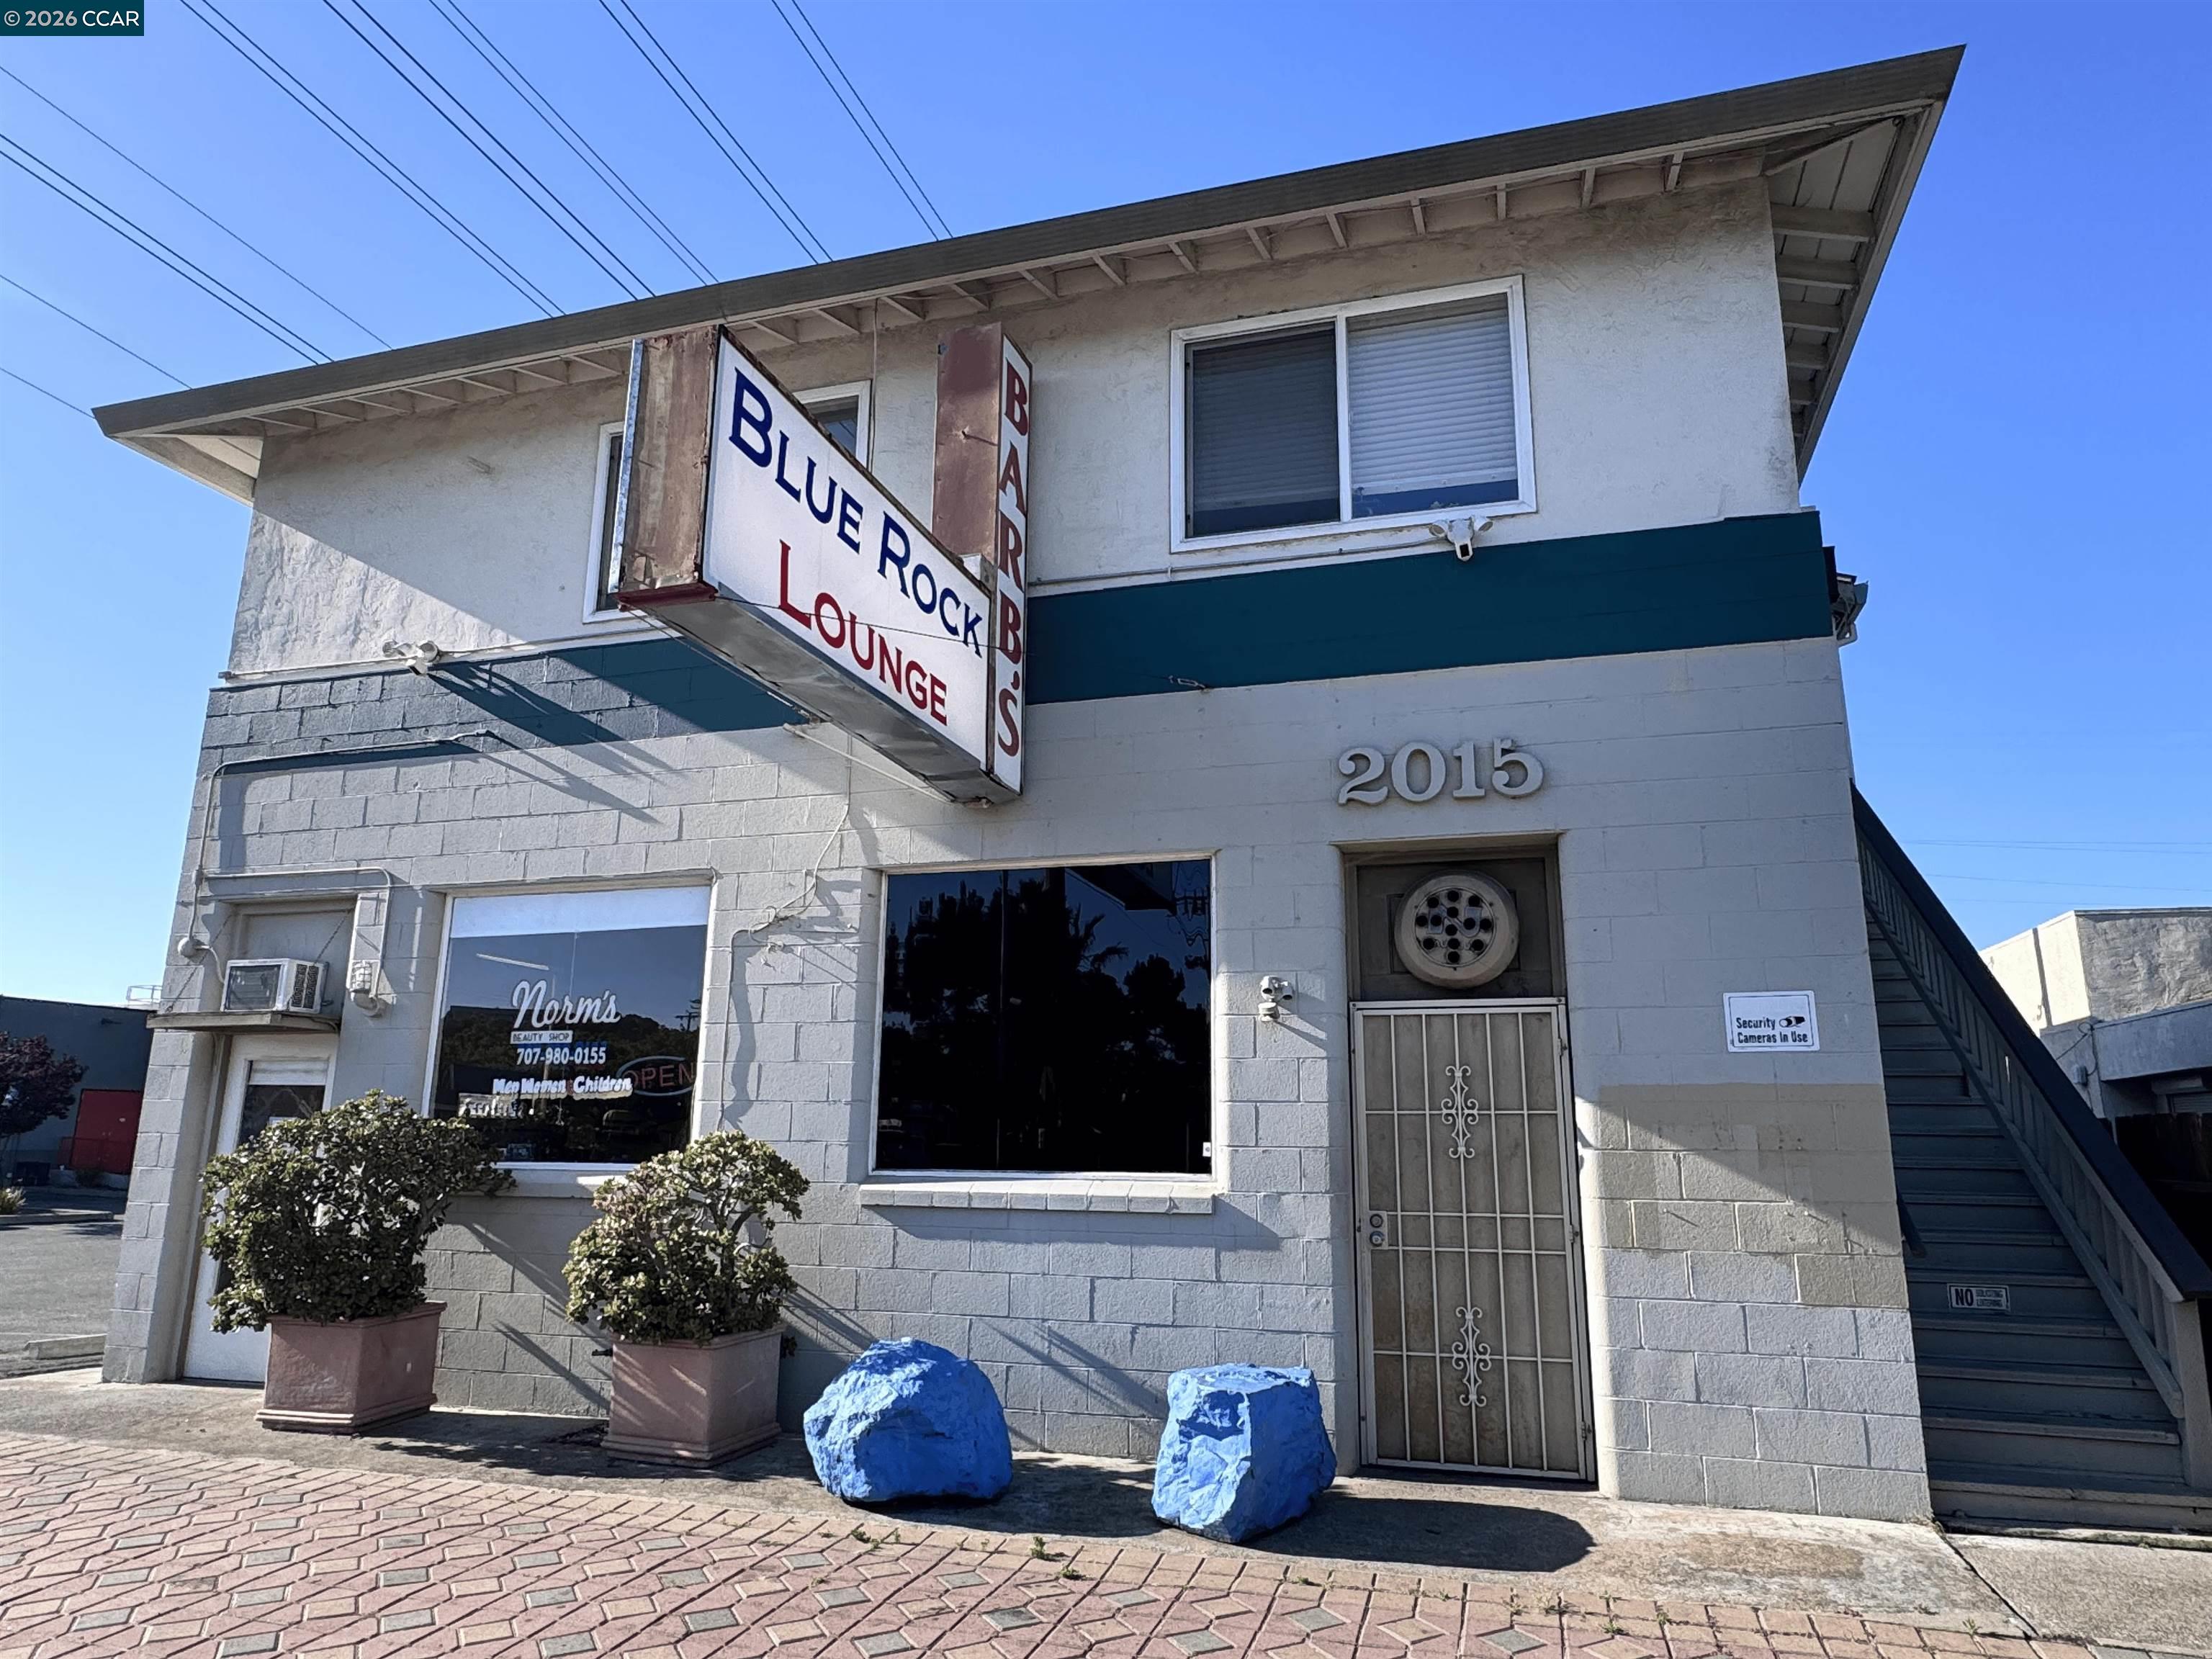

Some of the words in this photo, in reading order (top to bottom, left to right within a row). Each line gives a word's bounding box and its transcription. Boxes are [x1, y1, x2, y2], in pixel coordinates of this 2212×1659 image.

[728, 367, 863, 554] BLUE
[877, 511, 983, 659] ROCK
[997, 357, 1028, 757] BARB'S
[778, 539, 948, 726] LOUNGE
[1338, 737, 1545, 806] 2015
[512, 979, 621, 1029] Norm's
[1736, 1016, 1776, 1030] Security
[549, 1033, 570, 1041] SHOP
[1737, 1032, 1777, 1043] Cameras
[1779, 1031, 1789, 1043] In
[1791, 1030, 1808, 1043] Use
[516, 1047, 606, 1065] 707-980-0155
[493, 1079, 520, 1094] Men
[521, 1078, 567, 1094] Women
[573, 1075, 632, 1094] Children
[621, 1062, 696, 1089] OPEN
[1954, 1288, 1974, 1306] NO
